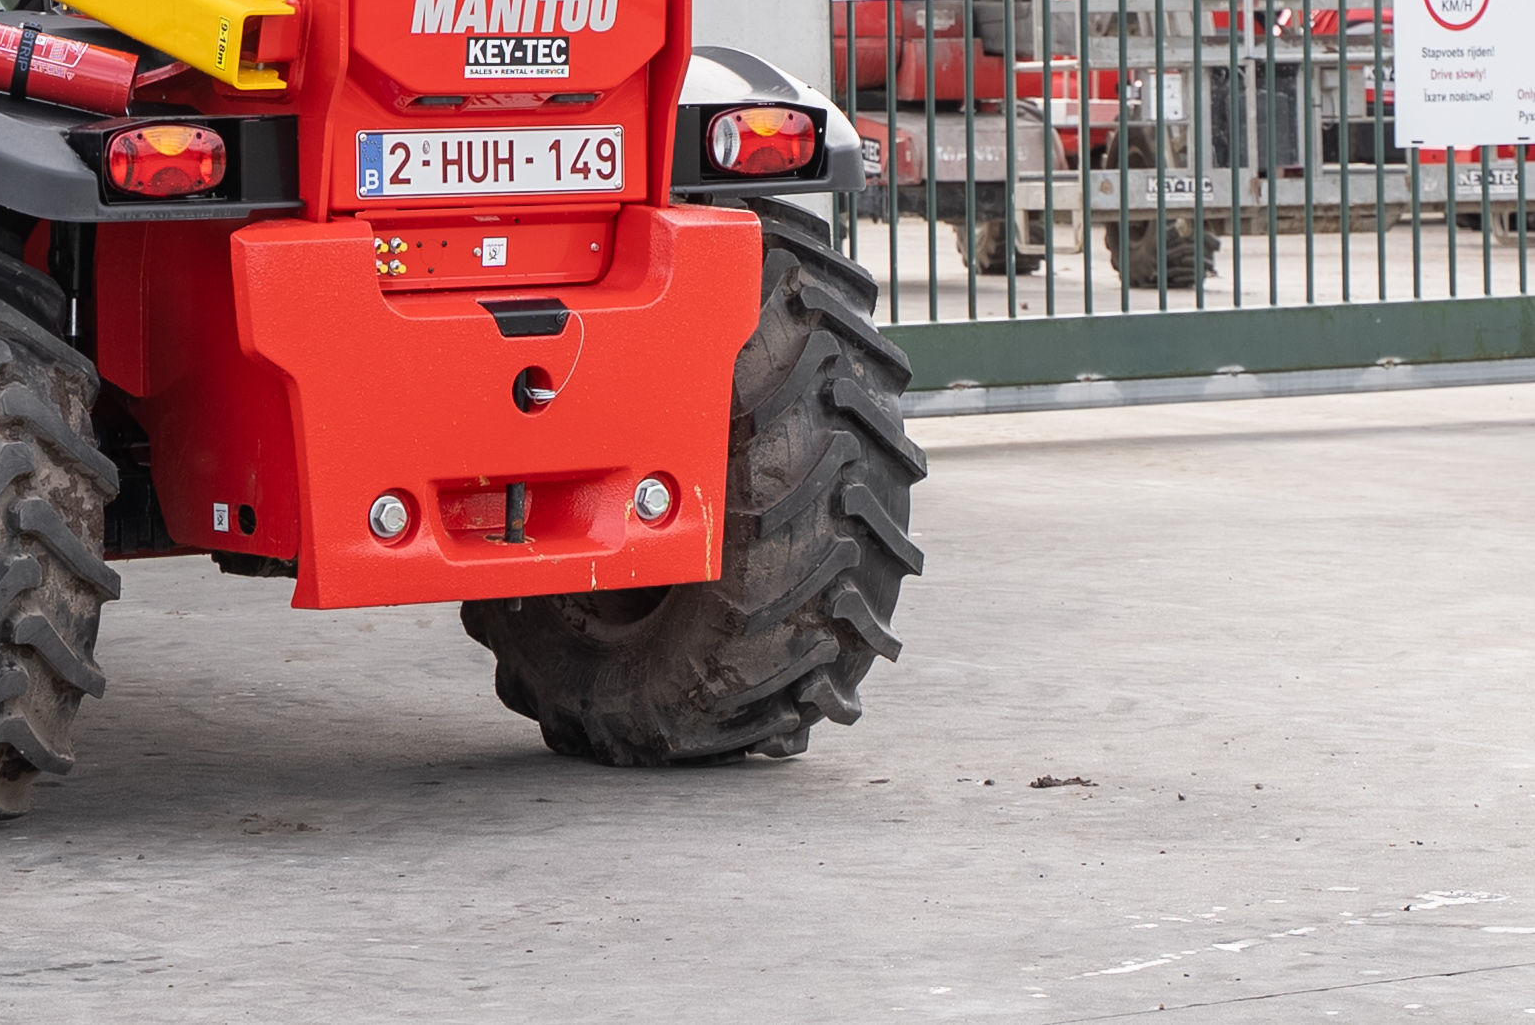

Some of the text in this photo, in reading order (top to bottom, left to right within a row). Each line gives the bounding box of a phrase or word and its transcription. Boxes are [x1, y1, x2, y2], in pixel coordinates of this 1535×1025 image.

[1441, 0, 1473, 12] KM/H
[468, 39, 567, 64] KEY-TEC
[1421, 47, 1465, 60] Stapvoets
[469, 68, 566, 76] SALES RENTAL SERVICE
[1430, 67, 1486, 82] Drive slowly!
[365, 169, 380, 190] B
